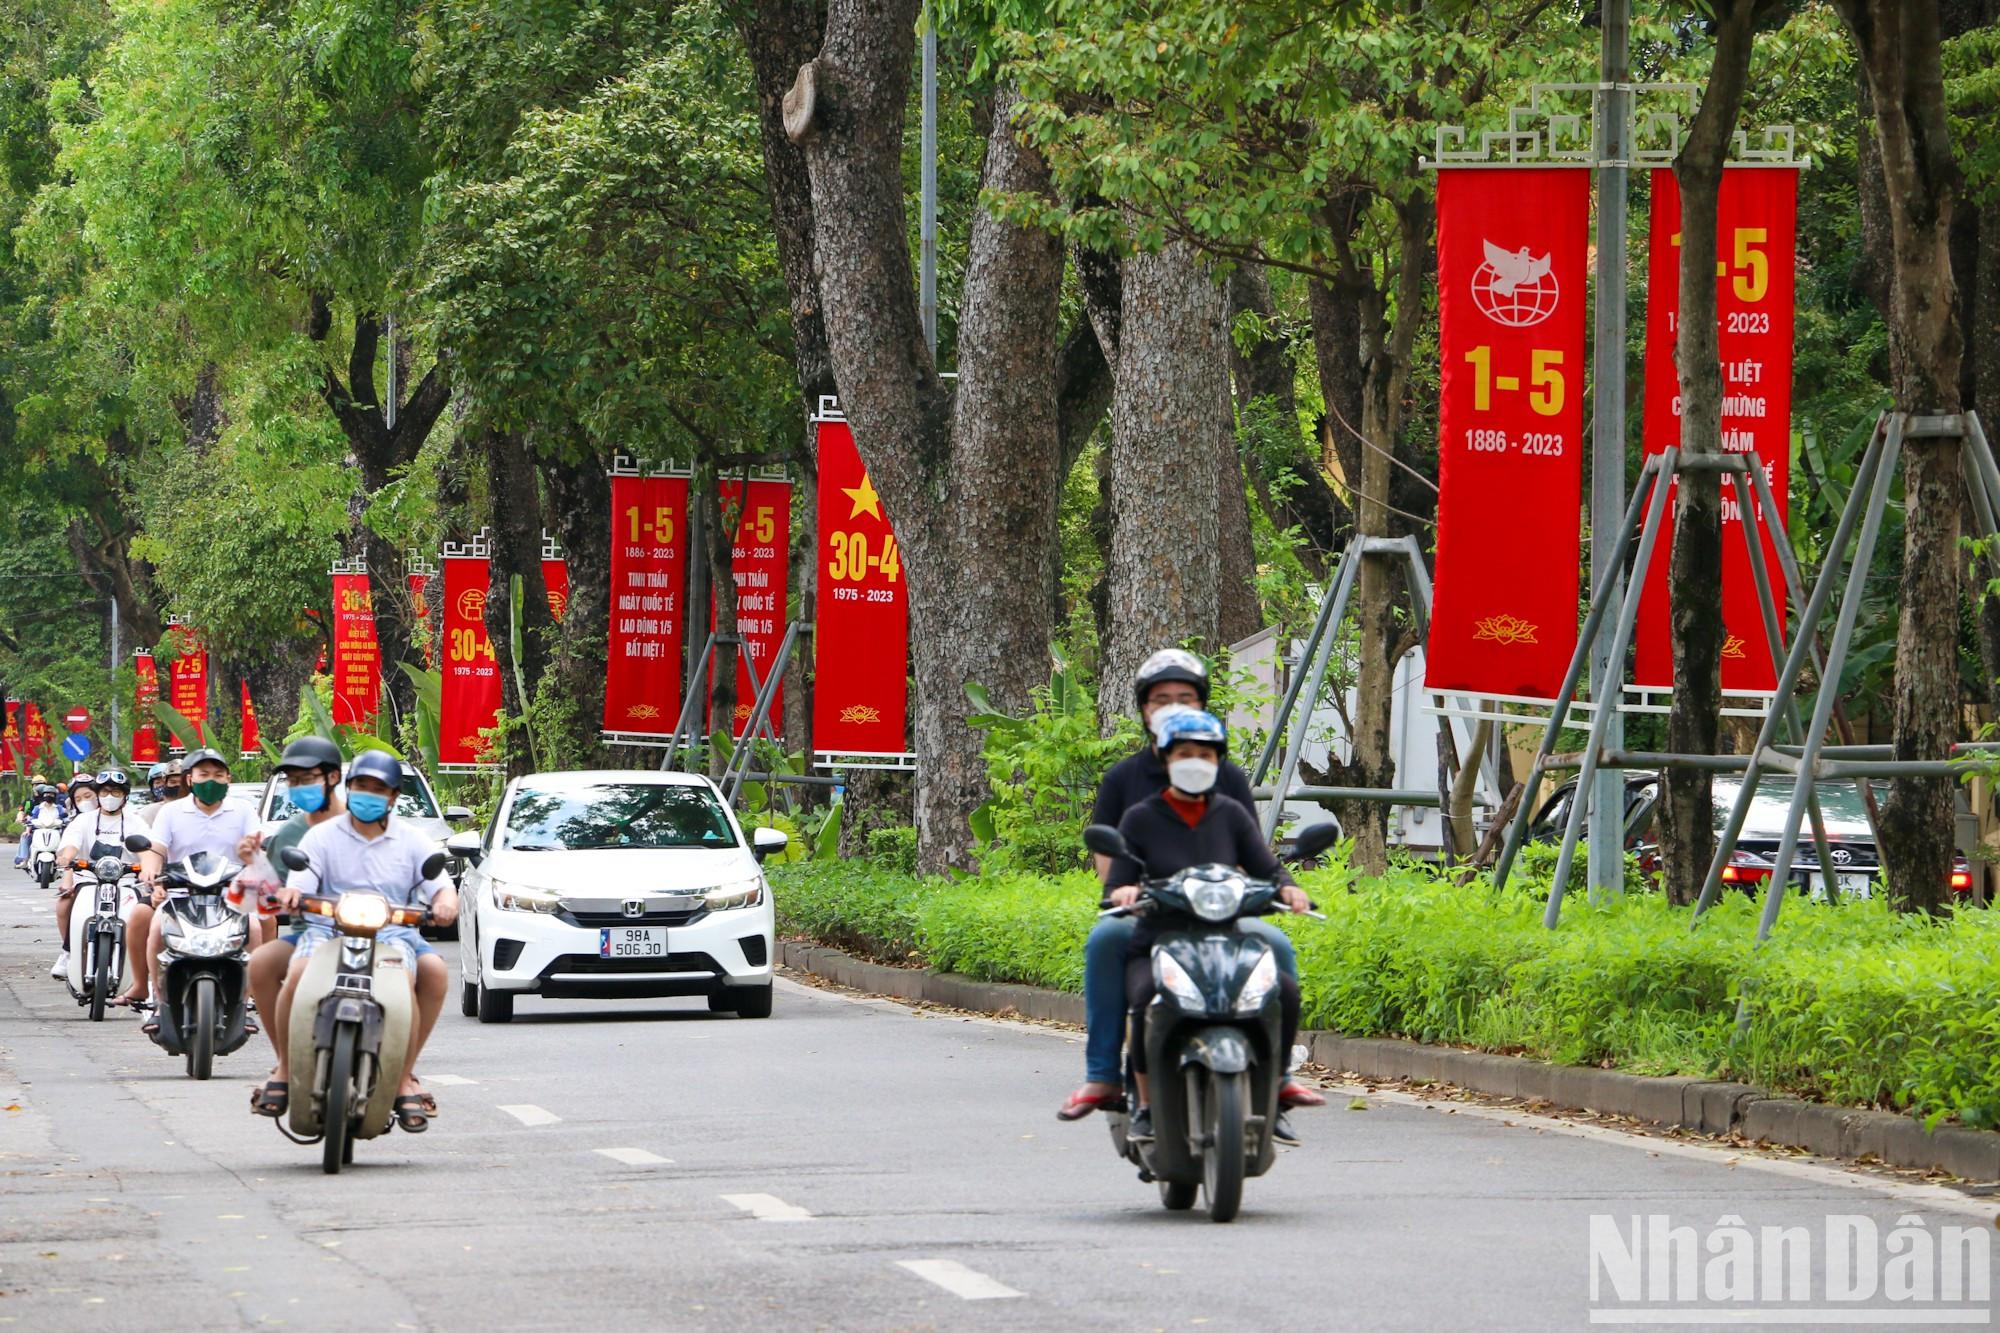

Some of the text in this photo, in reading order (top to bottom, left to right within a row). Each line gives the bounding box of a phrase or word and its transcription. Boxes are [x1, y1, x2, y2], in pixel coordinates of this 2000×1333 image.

[1728, 312, 1769, 334] 2023
[1464, 345, 1565, 417] 1-5
[1729, 358, 1762, 386] LIỆT
[1721, 392, 1766, 417] MỪNG
[1465, 429, 1563, 456] 1886 - 2023
[626, 506, 674, 544] 1-5
[625, 546, 644, 558] 1886
[653, 548, 674, 559] 2023
[753, 547, 775, 559] 2023
[829, 530, 900, 583] 30-4
[628, 569, 668, 588] TINH THẦN
[748, 568, 768, 588] THẦN
[619, 591, 675, 612] NGÀY QUỐC TẾ
[742, 591, 763, 612] QUỐC
[765, 591, 775, 611] TẾ
[833, 588, 858, 600] 1975
[867, 589, 893, 602] 2023
[620, 616, 673, 637] LAO ĐỘNG 1/5
[761, 619, 773, 634] 1/5
[450, 628, 496, 662] 30-4
[626, 637, 642, 657] BẤT
[643, 639, 660, 661] DIỆT
[175, 657, 202, 674] 7-5
[454, 666, 471, 676] 1975
[476, 667, 494, 677] 2023
[626, 929, 650, 942] 98A
[616, 943, 661, 956] 506.30
